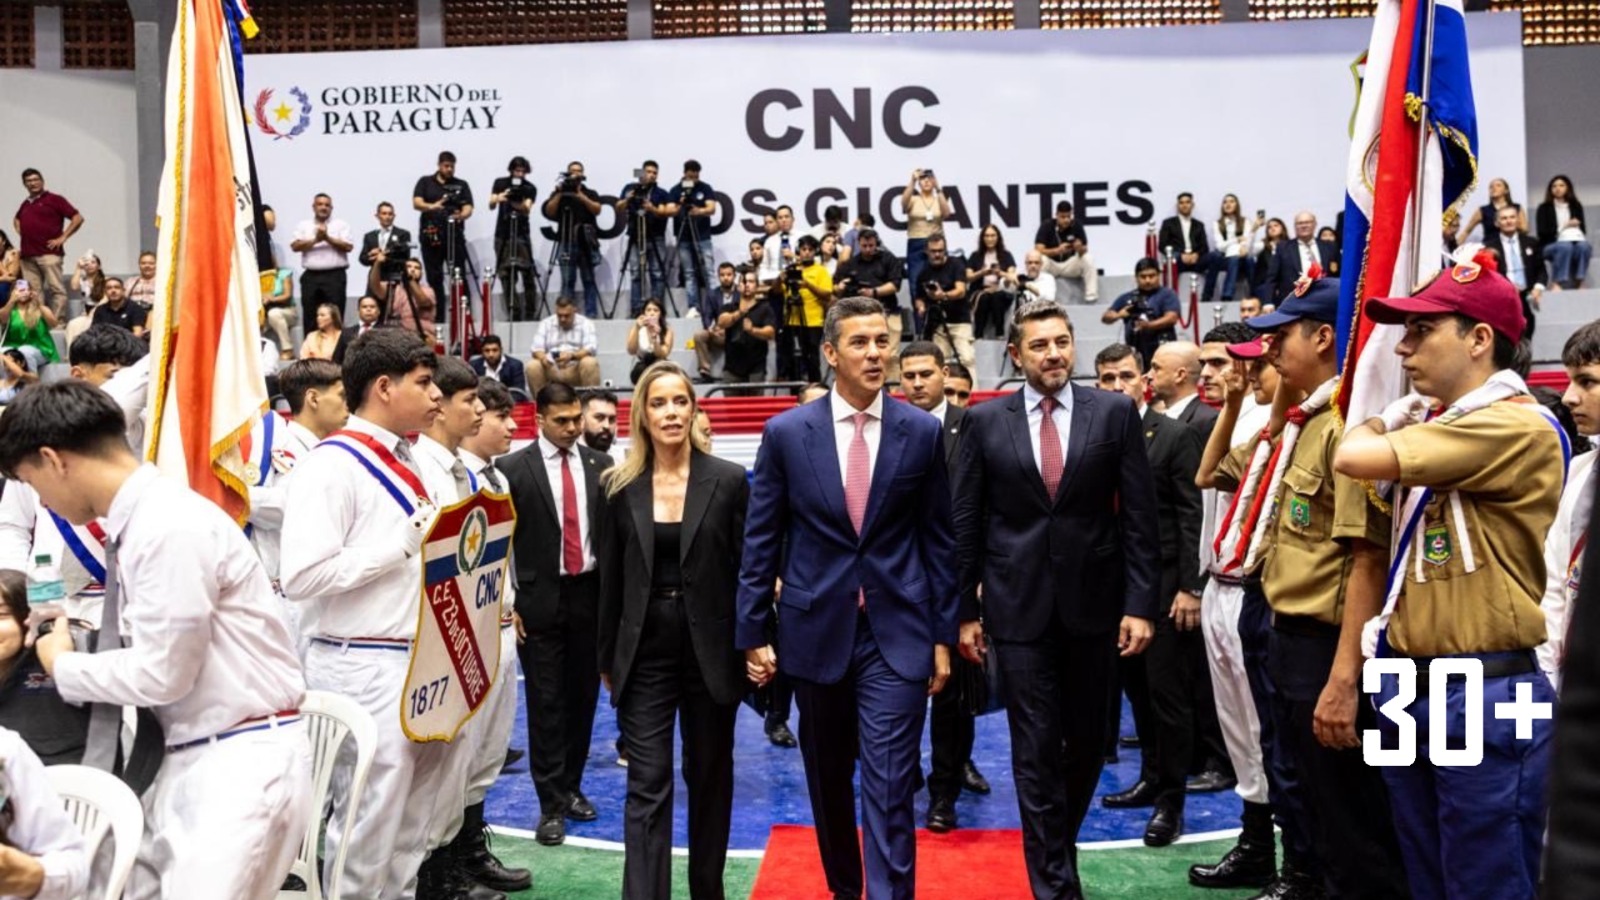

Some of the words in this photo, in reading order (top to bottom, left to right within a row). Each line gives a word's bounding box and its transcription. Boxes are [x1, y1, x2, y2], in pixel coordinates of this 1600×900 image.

[321, 83, 464, 107] GOBIERNO
[468, 88, 502, 102] DEL
[322, 106, 501, 135] PARAGUAY
[745, 85, 942, 152] CNC
[476, 568, 502, 609] CNC
[453, 627, 485, 704] OCTUBRE
[410, 675, 450, 719] 1877
